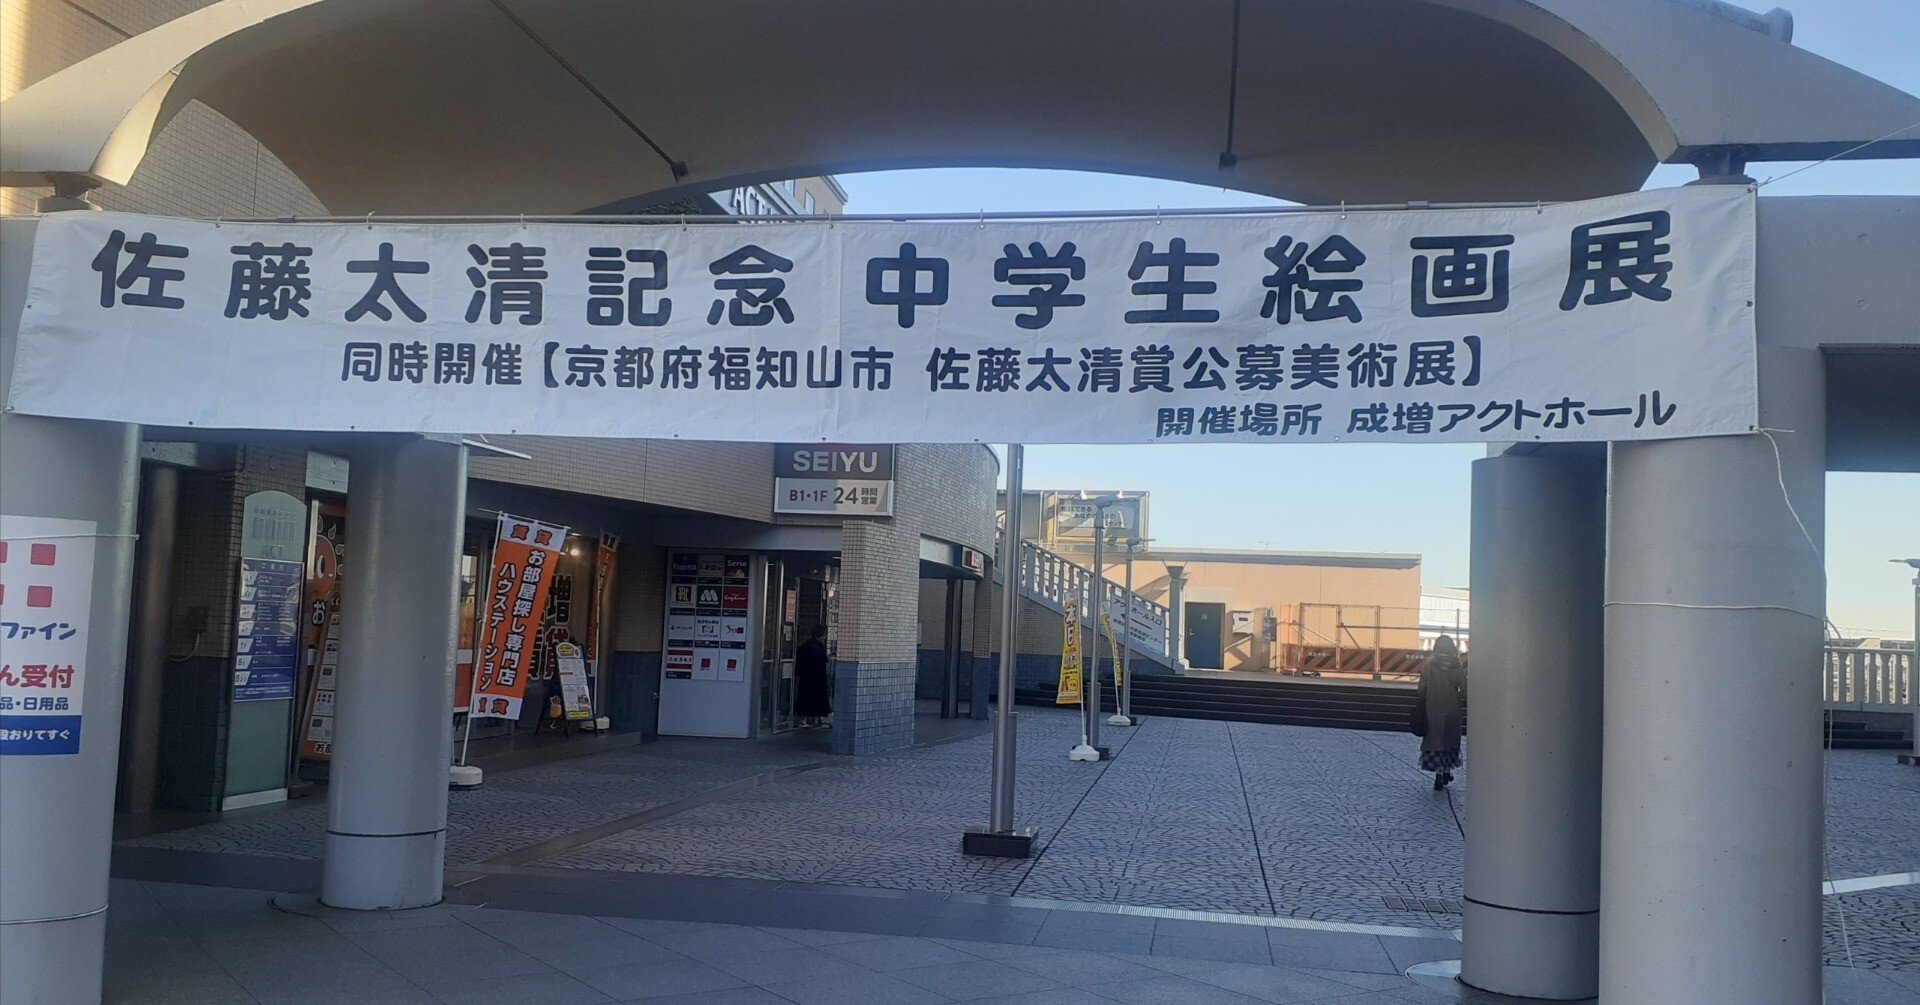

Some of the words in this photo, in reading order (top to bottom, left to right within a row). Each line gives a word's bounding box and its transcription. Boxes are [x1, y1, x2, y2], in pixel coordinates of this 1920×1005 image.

[92, 230, 795, 327] 佐藤太清記念
[866, 210, 1673, 329] 中学生絵画展
[926, 335, 1481, 393] 佐藤太清賞公募美術展】
[1156, 402, 1323, 438] 開催場所
[1347, 390, 1676, 434] 成増アクトホール
[793, 450, 878, 473] SEIYU
[832, 486, 859, 505] 24
[861, 487, 878, 496] 時間
[479, 562, 516, 692] ハウステーション
[496, 549, 546, 687] お部屋探し専門店
[1114, 598, 1163, 626] アクホール入口
